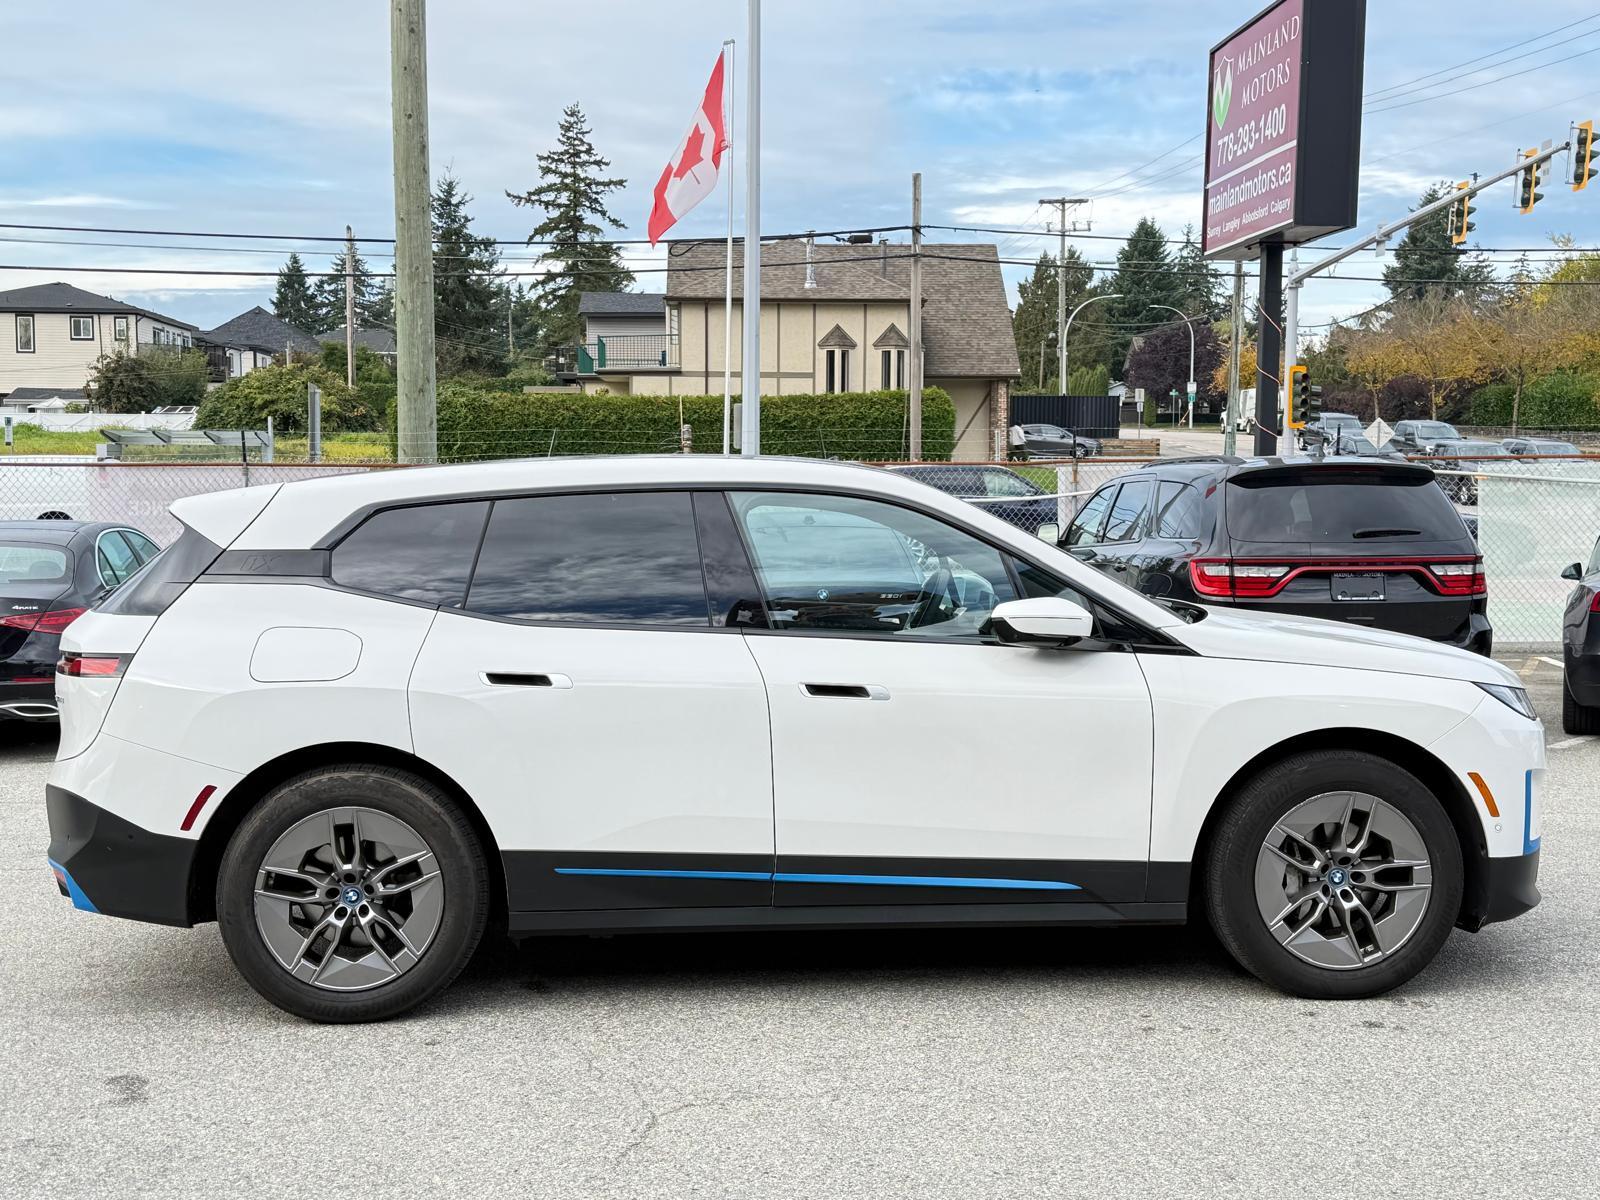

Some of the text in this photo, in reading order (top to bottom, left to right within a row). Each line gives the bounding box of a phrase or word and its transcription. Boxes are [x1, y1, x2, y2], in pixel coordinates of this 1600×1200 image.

[1237, 15, 1300, 74] MAINLAND
[1240, 57, 1292, 110] MOTORS
[1216, 103, 1287, 168] 778-293-1400
[1208, 162, 1292, 217] mainlandmotors.ca
[1207, 197, 1292, 239] Surrey Langley Abbotsford Calgary
